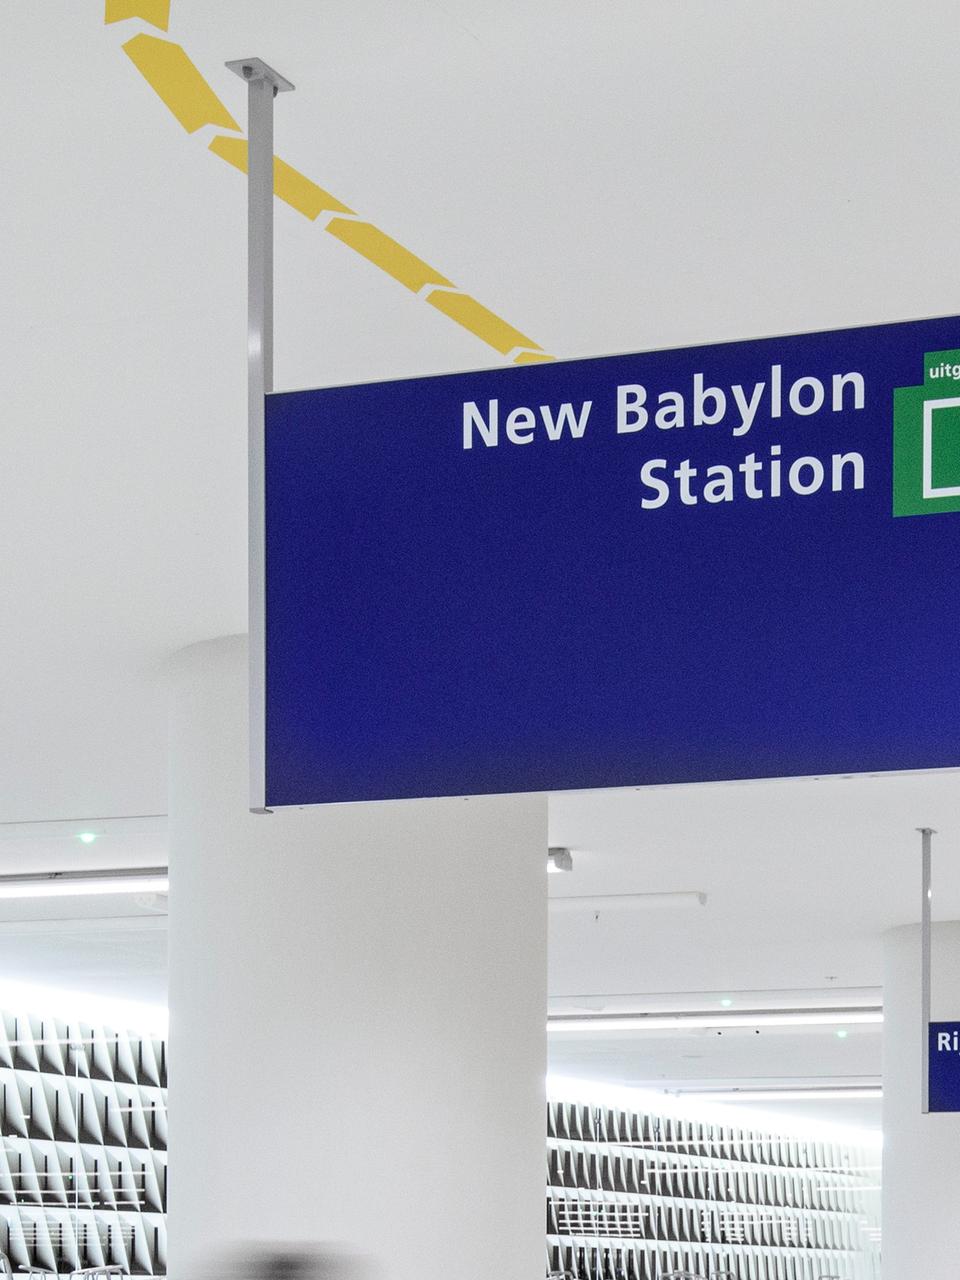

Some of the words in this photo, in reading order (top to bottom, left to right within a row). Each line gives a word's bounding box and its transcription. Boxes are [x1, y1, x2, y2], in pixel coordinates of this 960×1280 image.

[462, 398, 593, 450] New
[616, 365, 866, 437] Babylon
[640, 446, 865, 510] Station
